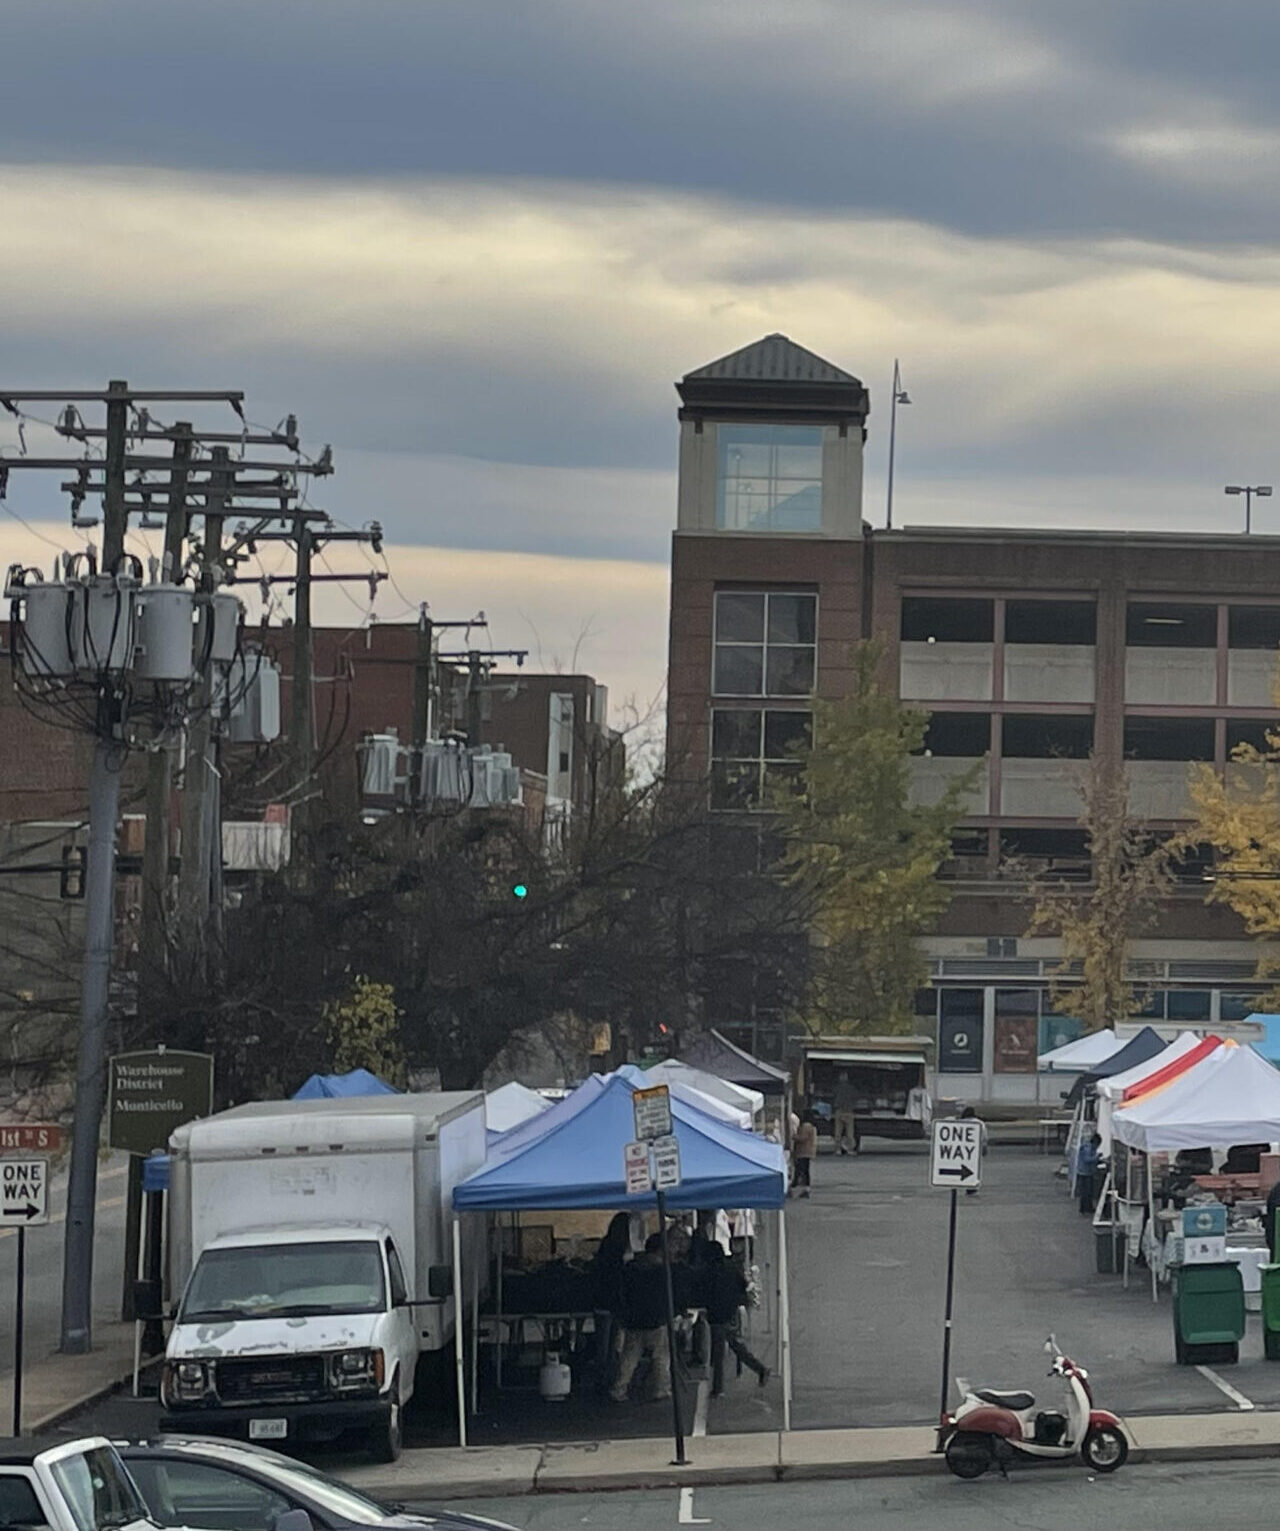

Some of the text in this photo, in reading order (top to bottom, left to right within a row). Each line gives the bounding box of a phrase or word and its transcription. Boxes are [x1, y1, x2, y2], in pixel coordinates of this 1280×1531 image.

[116, 1064, 185, 1077] Warehouse
[116, 1078, 164, 1091] District
[114, 1099, 184, 1112] Monticello
[38, 1129, 49, 1147] S
[940, 1126, 975, 1142] ONE
[940, 1145, 975, 1160] WAY
[3, 1165, 41, 1181] ONE
[3, 1183, 42, 1199] WAY
